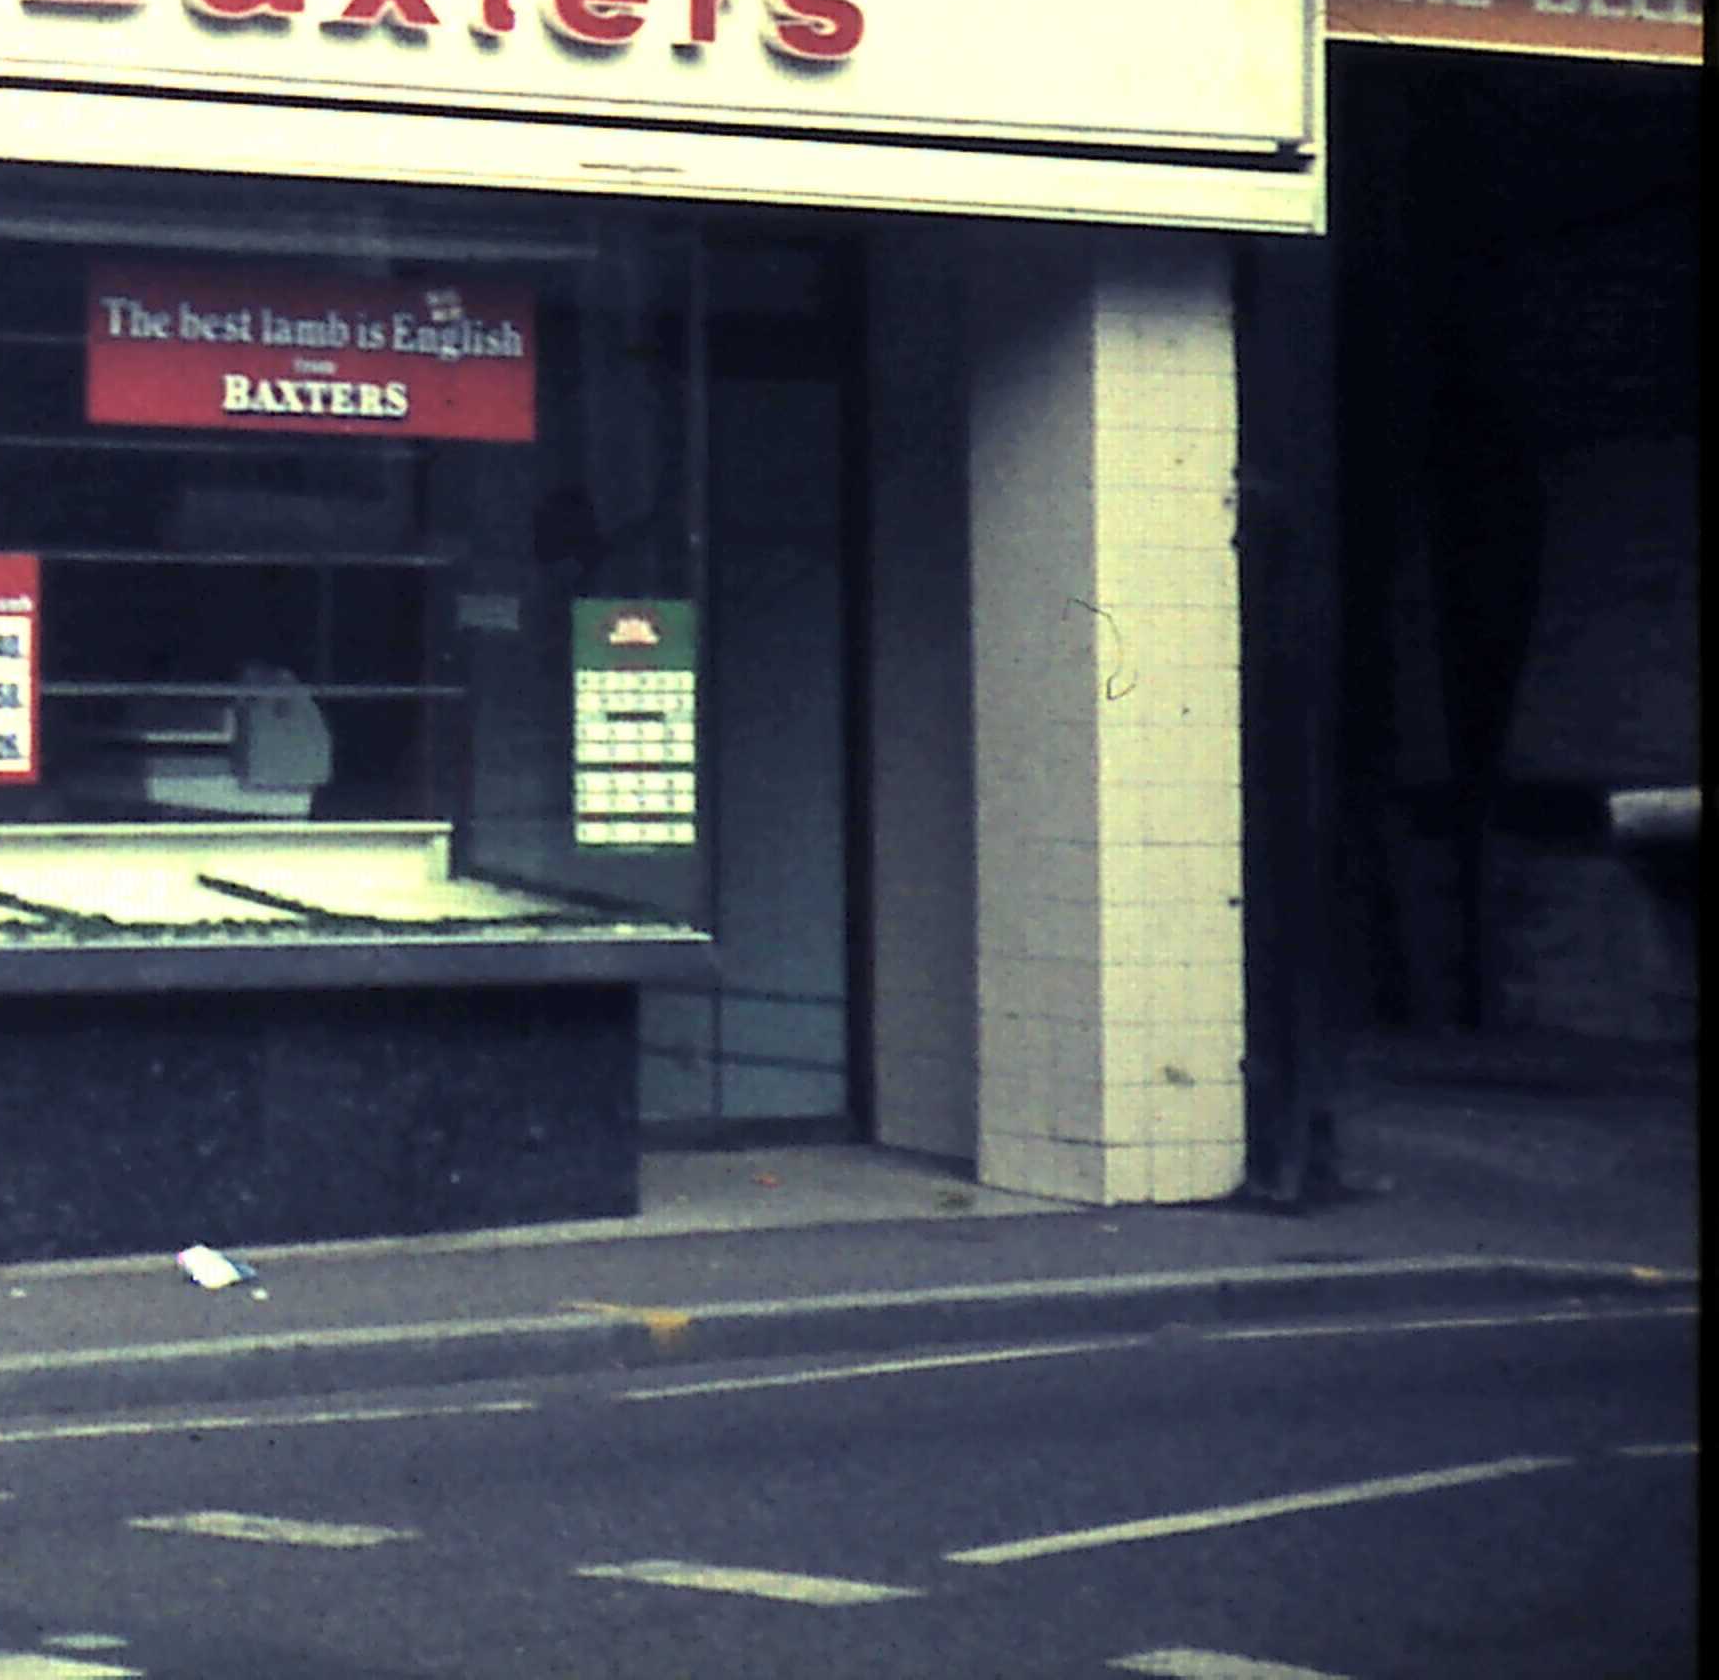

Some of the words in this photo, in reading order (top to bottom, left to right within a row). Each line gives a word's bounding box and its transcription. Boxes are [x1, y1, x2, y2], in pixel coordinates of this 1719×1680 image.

[101, 295, 171, 339] The
[179, 300, 254, 343] best
[262, 307, 350, 349] lamb
[356, 313, 388, 351] is
[392, 311, 524, 362] English
[222, 373, 410, 418] BAXTERS
